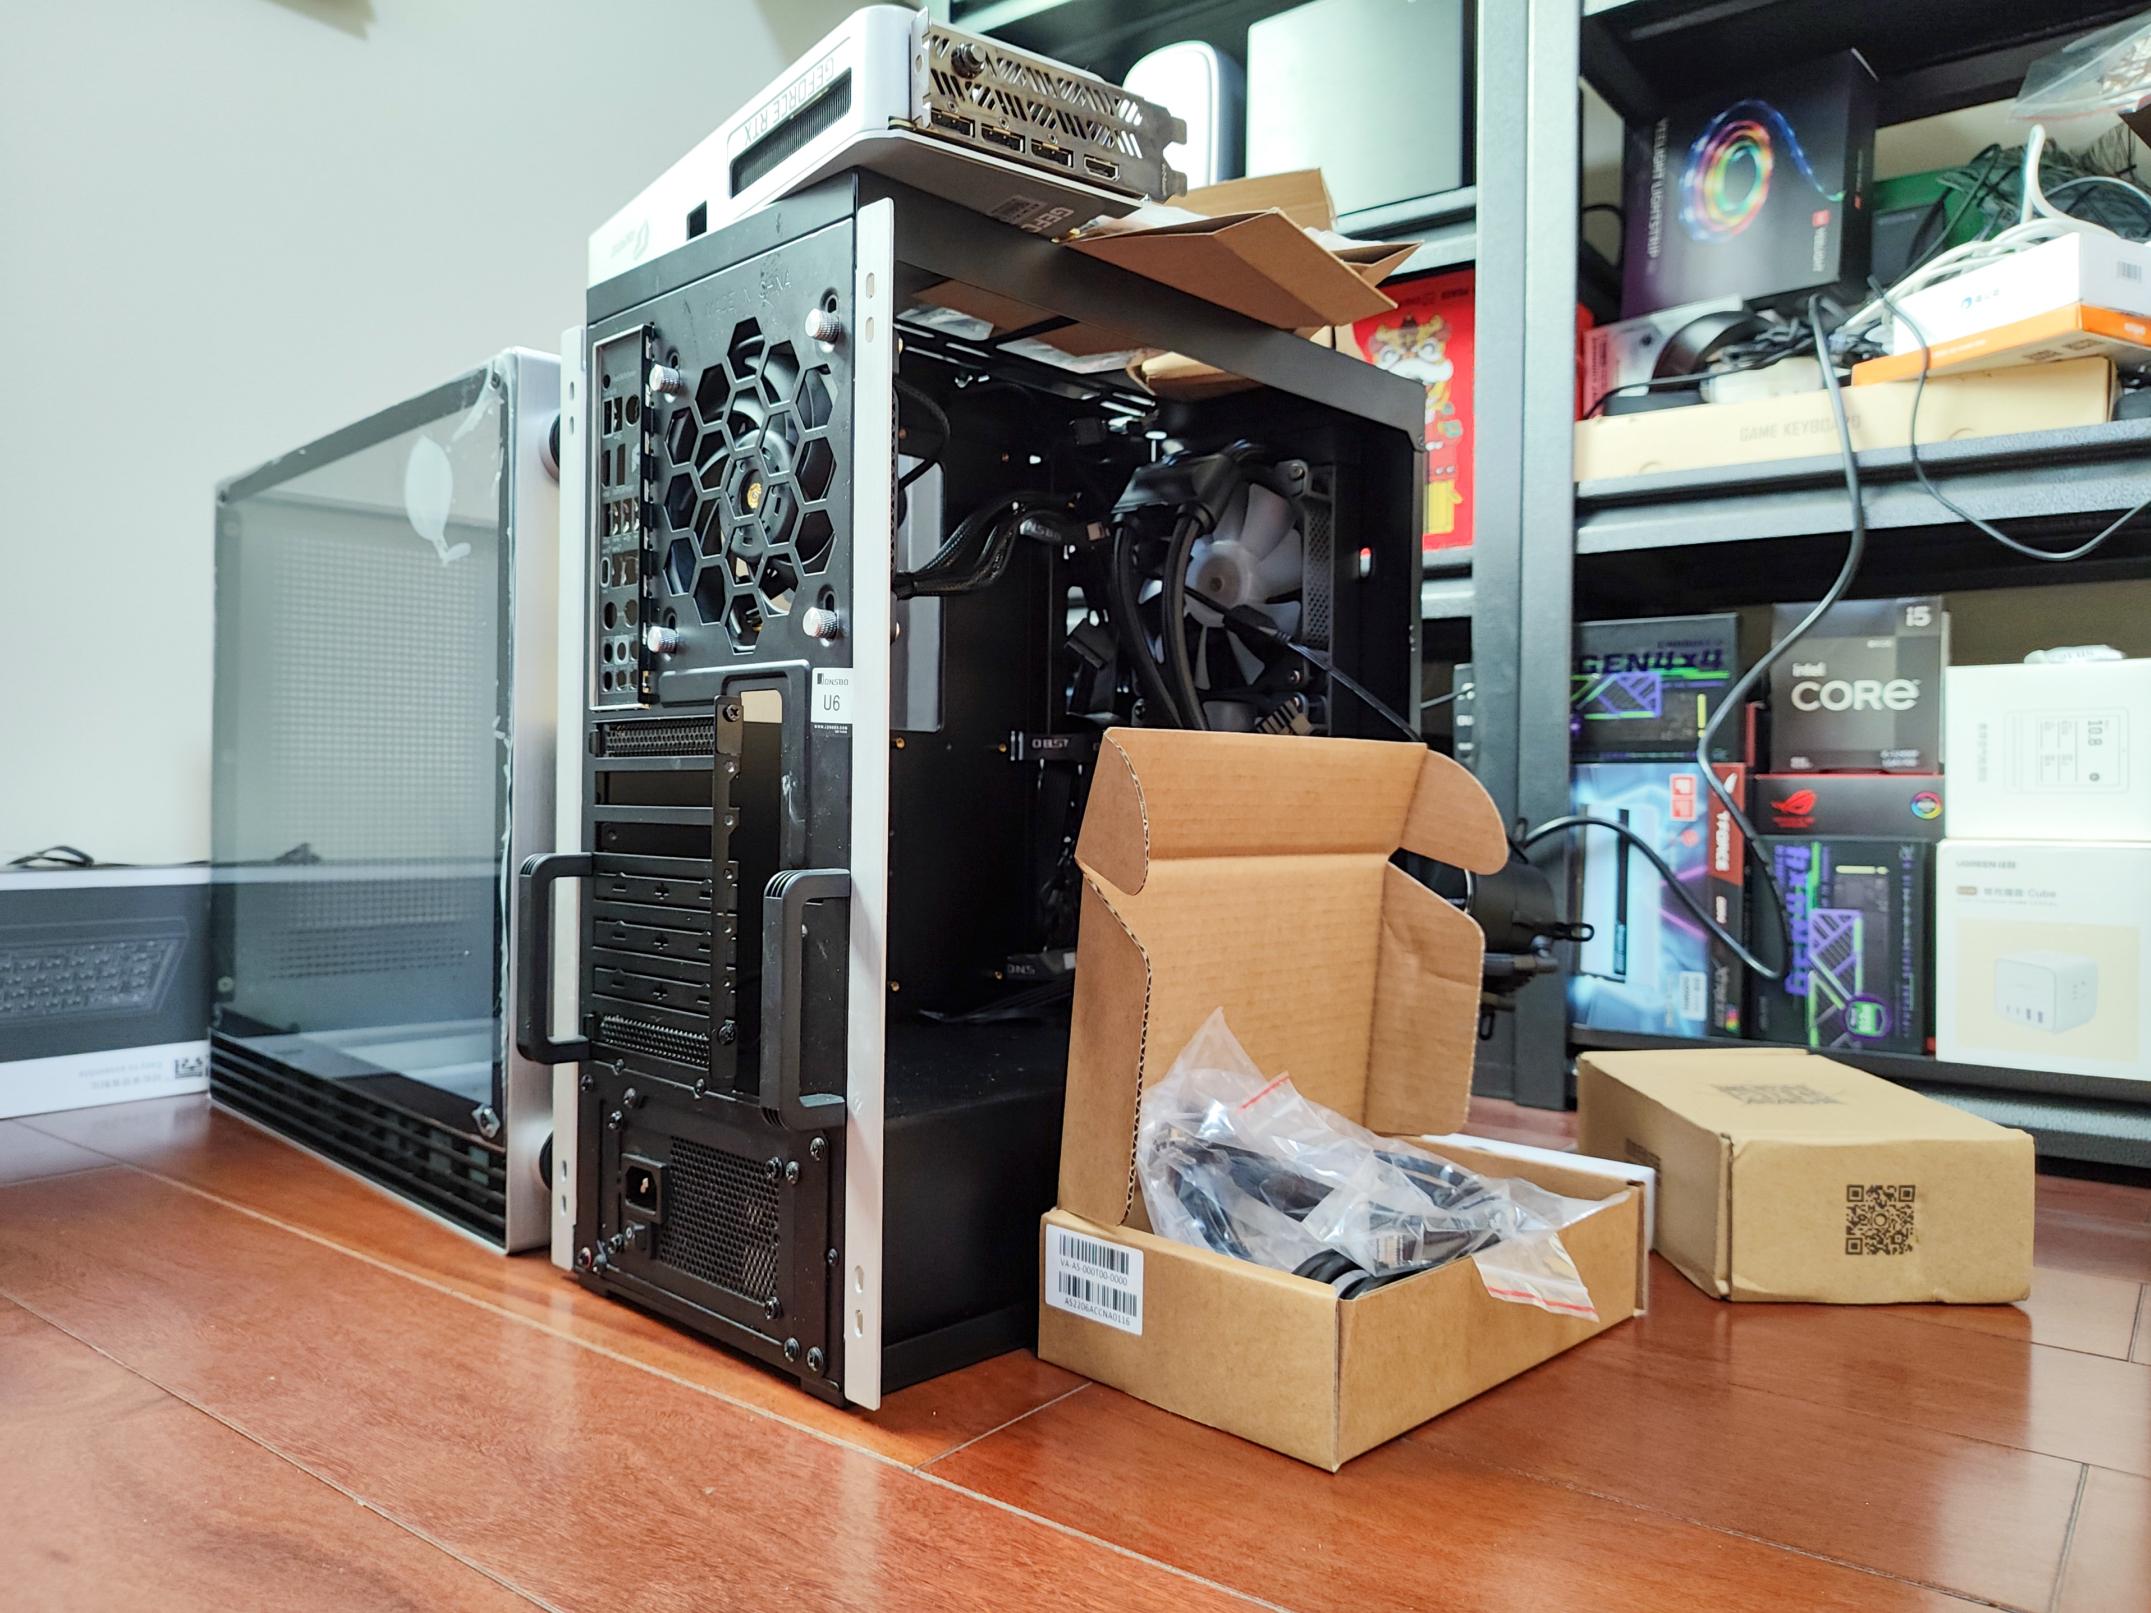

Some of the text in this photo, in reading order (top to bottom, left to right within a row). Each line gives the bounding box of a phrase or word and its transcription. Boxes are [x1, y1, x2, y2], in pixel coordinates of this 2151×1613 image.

[744, 57, 834, 146] GEFORCE RTX
[1739, 415, 1861, 441] GAME KEYBOD
[1906, 605, 1931, 627] i5
[1792, 662, 1827, 677] intel
[823, 694, 840, 711] U6
